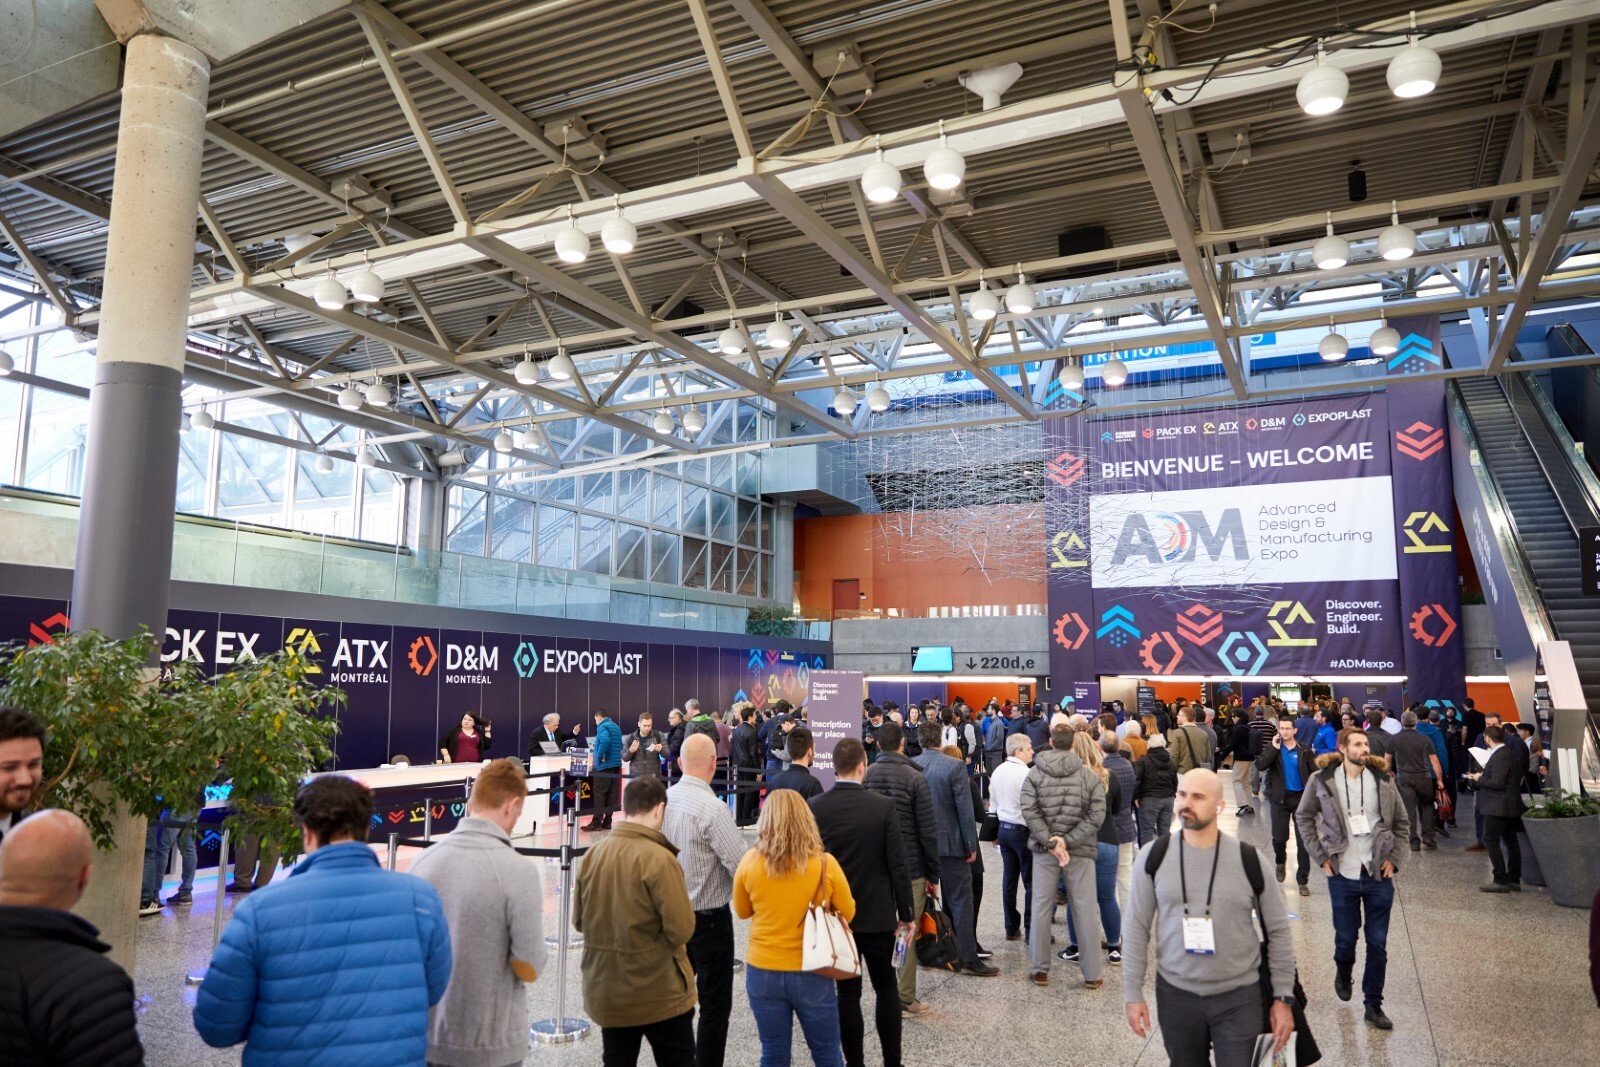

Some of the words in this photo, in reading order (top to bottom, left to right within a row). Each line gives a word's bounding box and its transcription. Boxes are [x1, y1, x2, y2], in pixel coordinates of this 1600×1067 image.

[1260, 417, 1286, 427] D&M
[1308, 408, 1372, 423] EXPOPLAST
[1156, 427, 1182, 436] PACK
[1183, 425, 1197, 434] EX
[1218, 422, 1239, 431] ATX
[1101, 454, 1225, 479] BIENVENUE
[1246, 442, 1374, 469] WELCOME
[1258, 501, 1336, 516] Advanced
[1259, 518, 1310, 532] Design
[1315, 516, 1326, 528] &
[1110, 508, 1250, 565] ADM
[1260, 530, 1373, 544] Manufacturing
[1261, 548, 1298, 562] Expo
[1325, 599, 1382, 610] Discover.
[1326, 611, 1383, 624] Engineer.
[1327, 623, 1360, 634] Build.
[160, 627, 207, 663] CK
[215, 630, 260, 665] EX
[331, 638, 389, 669] ATX
[446, 643, 499, 671] D&M
[543, 649, 643, 675] EXPOPLAST
[980, 656, 1035, 671] 220d,e
[1329, 659, 1394, 670] #ADMexpo
[330, 671, 389, 683] MONTRÉAL
[445, 673, 492, 684] MONTRÉAL
[811, 720, 851, 730] Inscription
[824, 730, 846, 739] place
